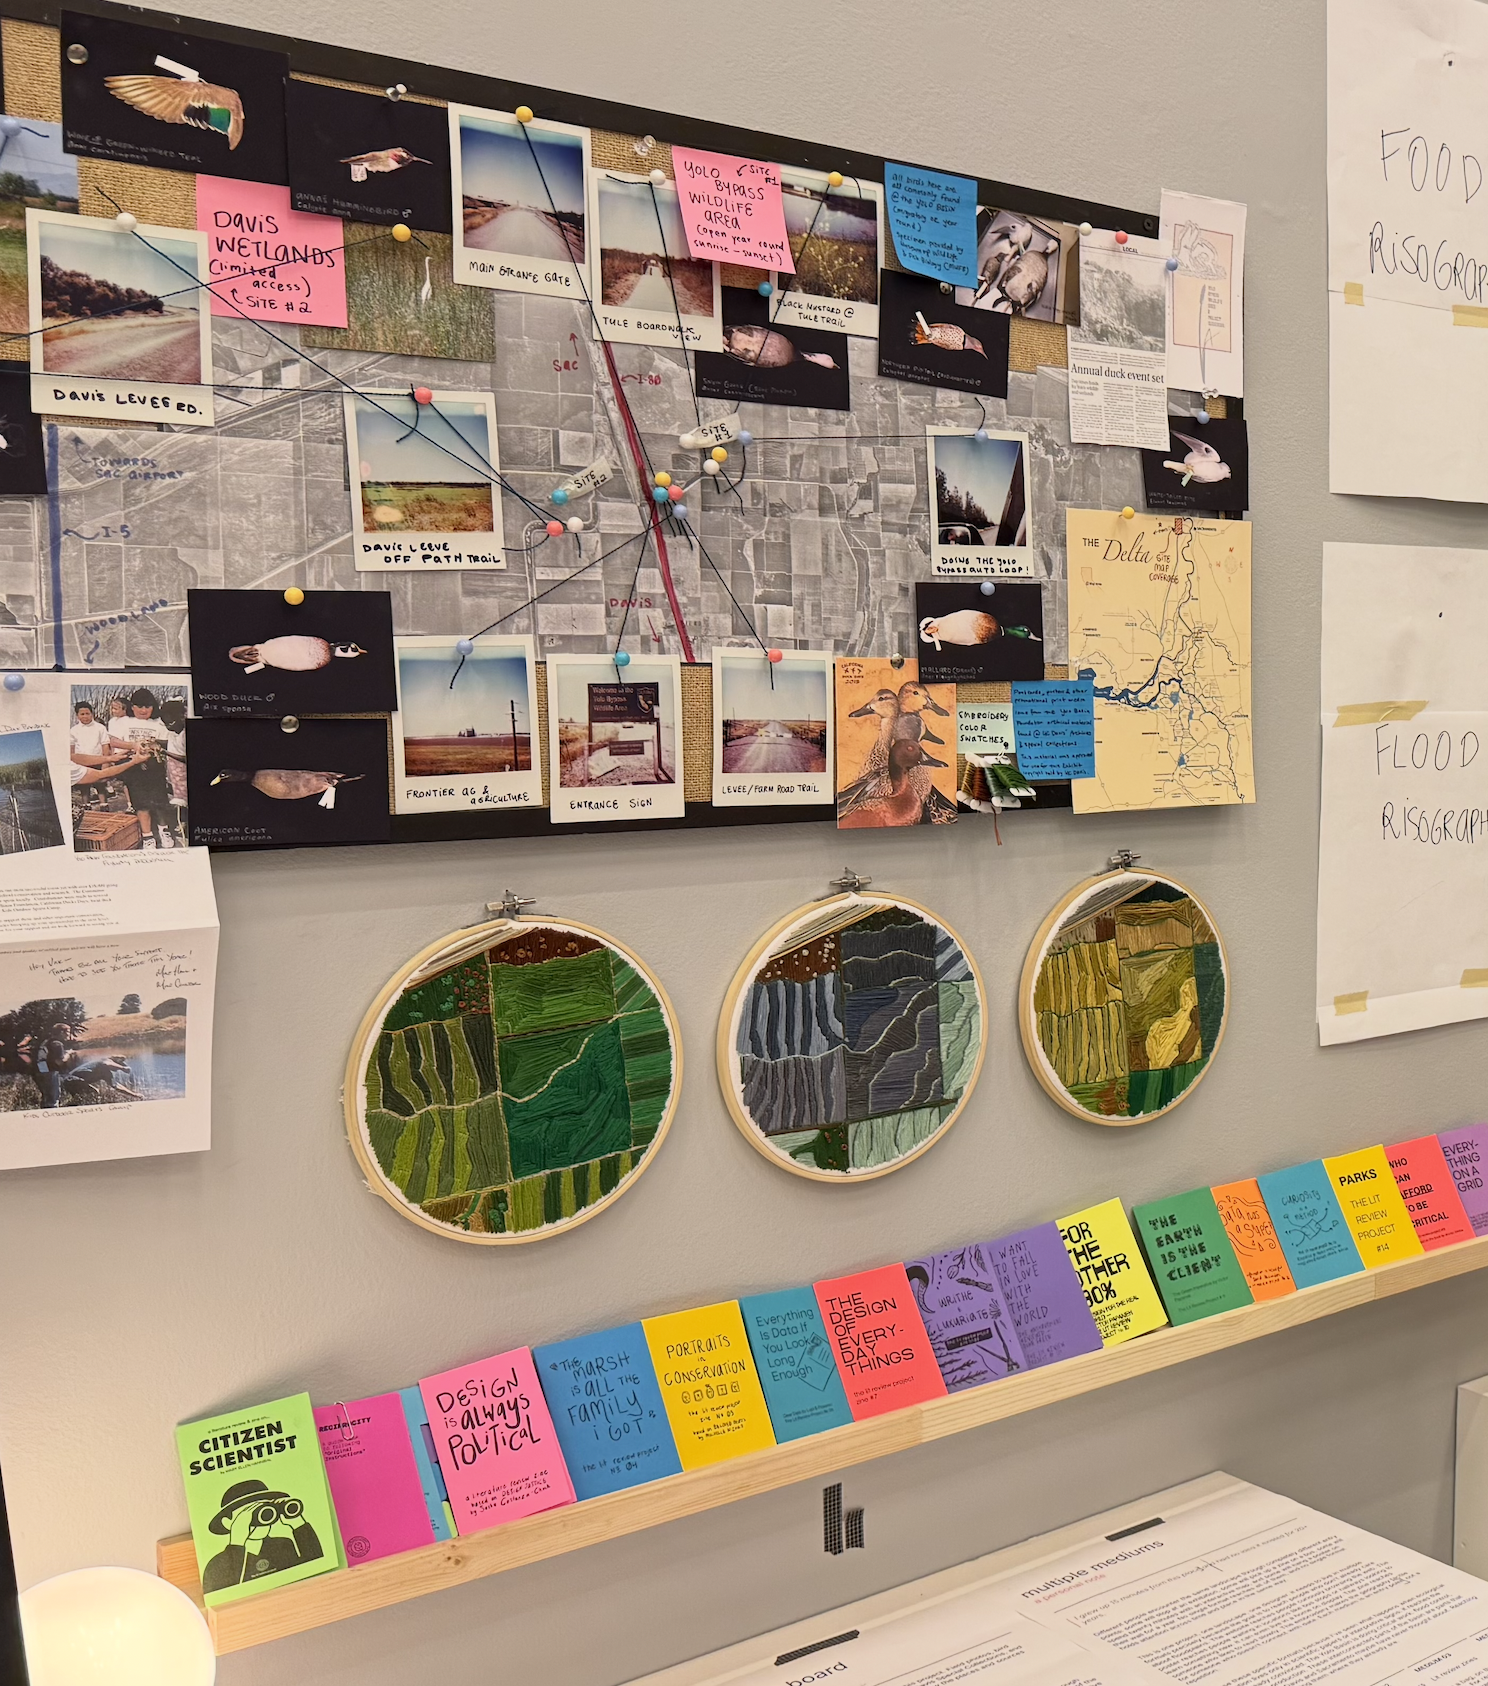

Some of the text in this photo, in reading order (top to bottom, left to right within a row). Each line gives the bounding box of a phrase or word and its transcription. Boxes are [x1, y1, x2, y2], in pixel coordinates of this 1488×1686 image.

[684, 160, 720, 179] YOLO
[1380, 127, 1483, 204] FOOD
[694, 239, 729, 253] sunrise
[732, 235, 751, 245] year
[759, 241, 784, 251] round
[1122, 246, 1139, 254] LOCAL
[844, 307, 855, 318] @
[1070, 363, 1165, 384] Annual duck event set
[1082, 532, 1154, 564] THE Delta
[383, 554, 411, 564] OFF
[1375, 723, 1480, 776] FLOOD
[1442, 1139, 1479, 1157] EVERY-
[1446, 1151, 1481, 1168] THING
[1338, 1168, 1378, 1187] PARKS
[1452, 1165, 1480, 1180] ON A
[1457, 1177, 1484, 1193] GRID
[1350, 1194, 1381, 1210] THE LIT
[1148, 1213, 1178, 1231] THE
[1355, 1209, 1388, 1225] REVIEW
[1155, 1223, 1203, 1249] EARTH
[1358, 1223, 1396, 1241] PROJECT
[1161, 1241, 1208, 1265] IS THE
[1376, 1243, 1390, 1253] #14
[1166, 1254, 1222, 1281] CLIENT
[825, 1292, 864, 1311] THE
[755, 1308, 815, 1327] Everything
[829, 1297, 898, 1326] DESIGN
[759, 1321, 809, 1340] Is Data If
[834, 1321, 856, 1337] OF
[838, 1323, 904, 1351] EVERY-
[763, 1337, 811, 1354] You Look
[840, 1343, 877, 1365] DAY
[559, 1356, 582, 1372] THE
[766, 1354, 796, 1369] Long
[845, 1347, 915, 1376] THINGS
[618, 1373, 641, 1386] THE
[771, 1364, 814, 1383] Enough
[198, 1421, 283, 1454] CITIZEN
[189, 1435, 298, 1476] SCIENTIST
[1021, 1539, 1164, 1600] multiple mediums
